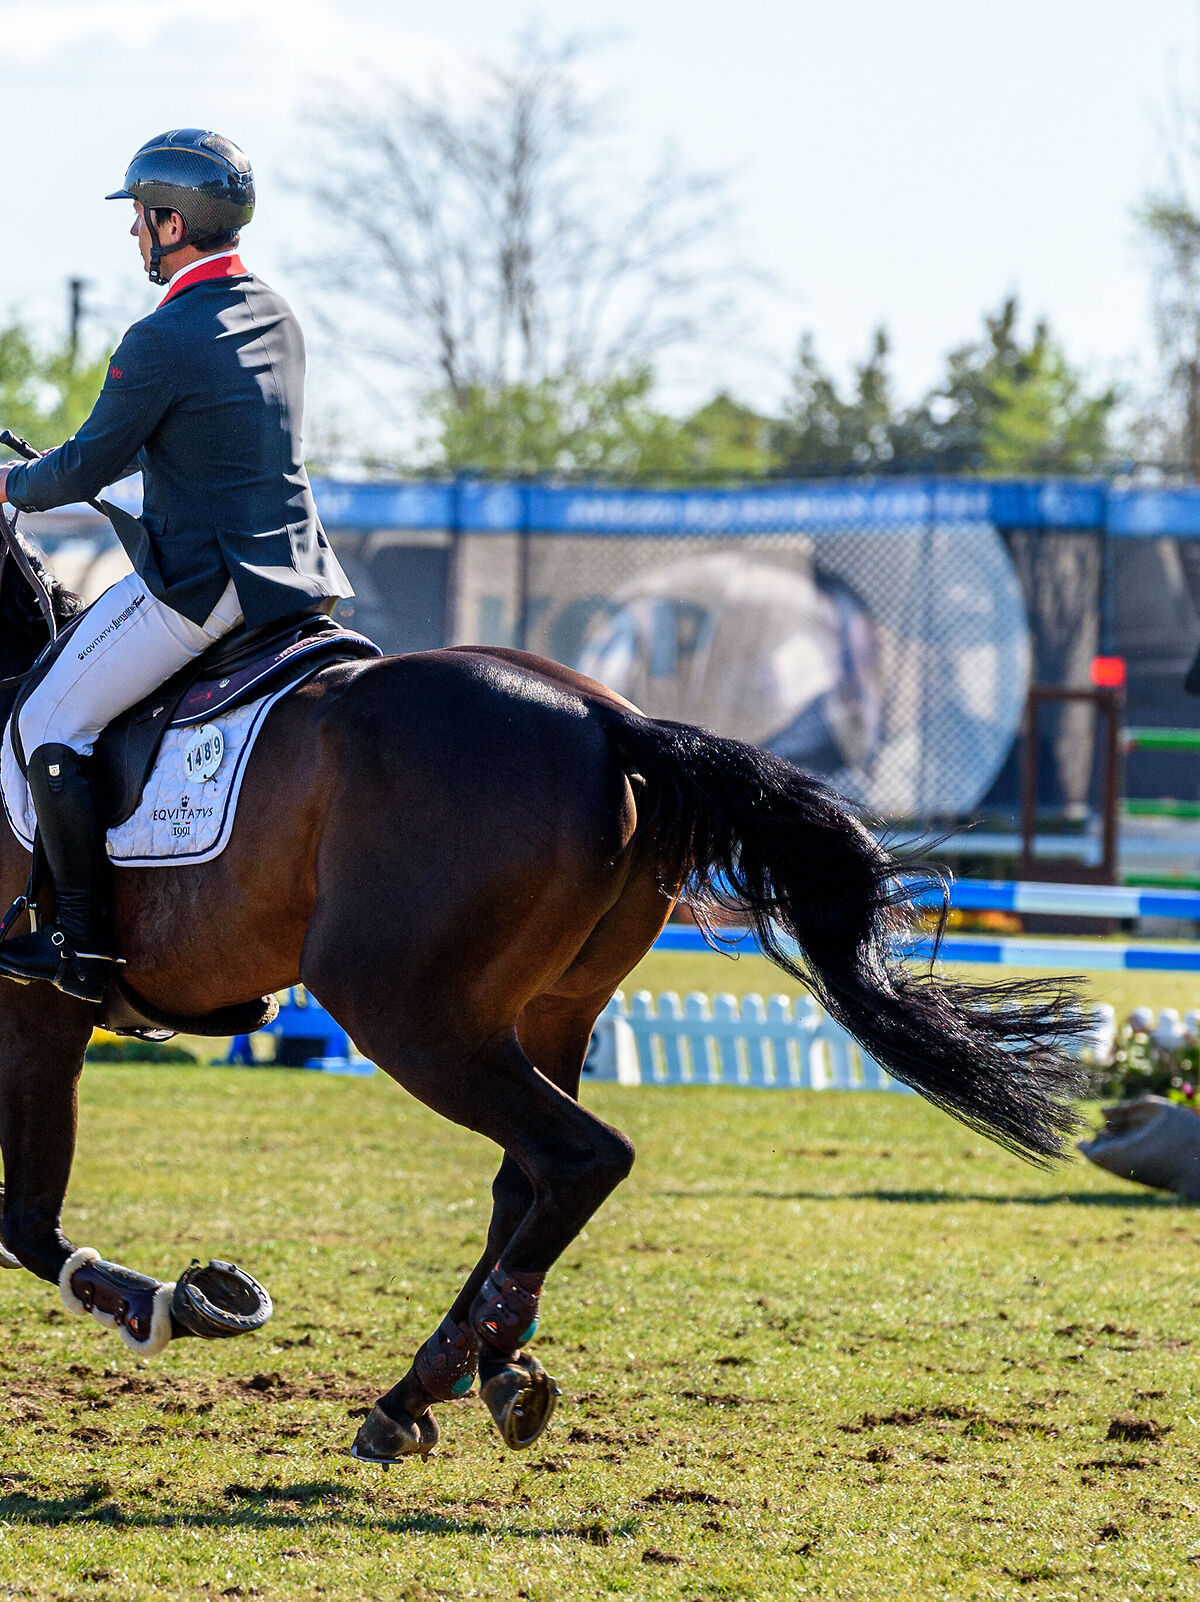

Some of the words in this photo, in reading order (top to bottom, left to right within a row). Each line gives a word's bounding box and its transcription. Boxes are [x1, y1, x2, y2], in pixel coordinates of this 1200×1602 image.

[83, 624, 115, 656] EQVITATVS
[186, 736, 221, 772] 1489
[153, 806, 214, 821] EQVITATVS
[172, 826, 191, 838] 1991
